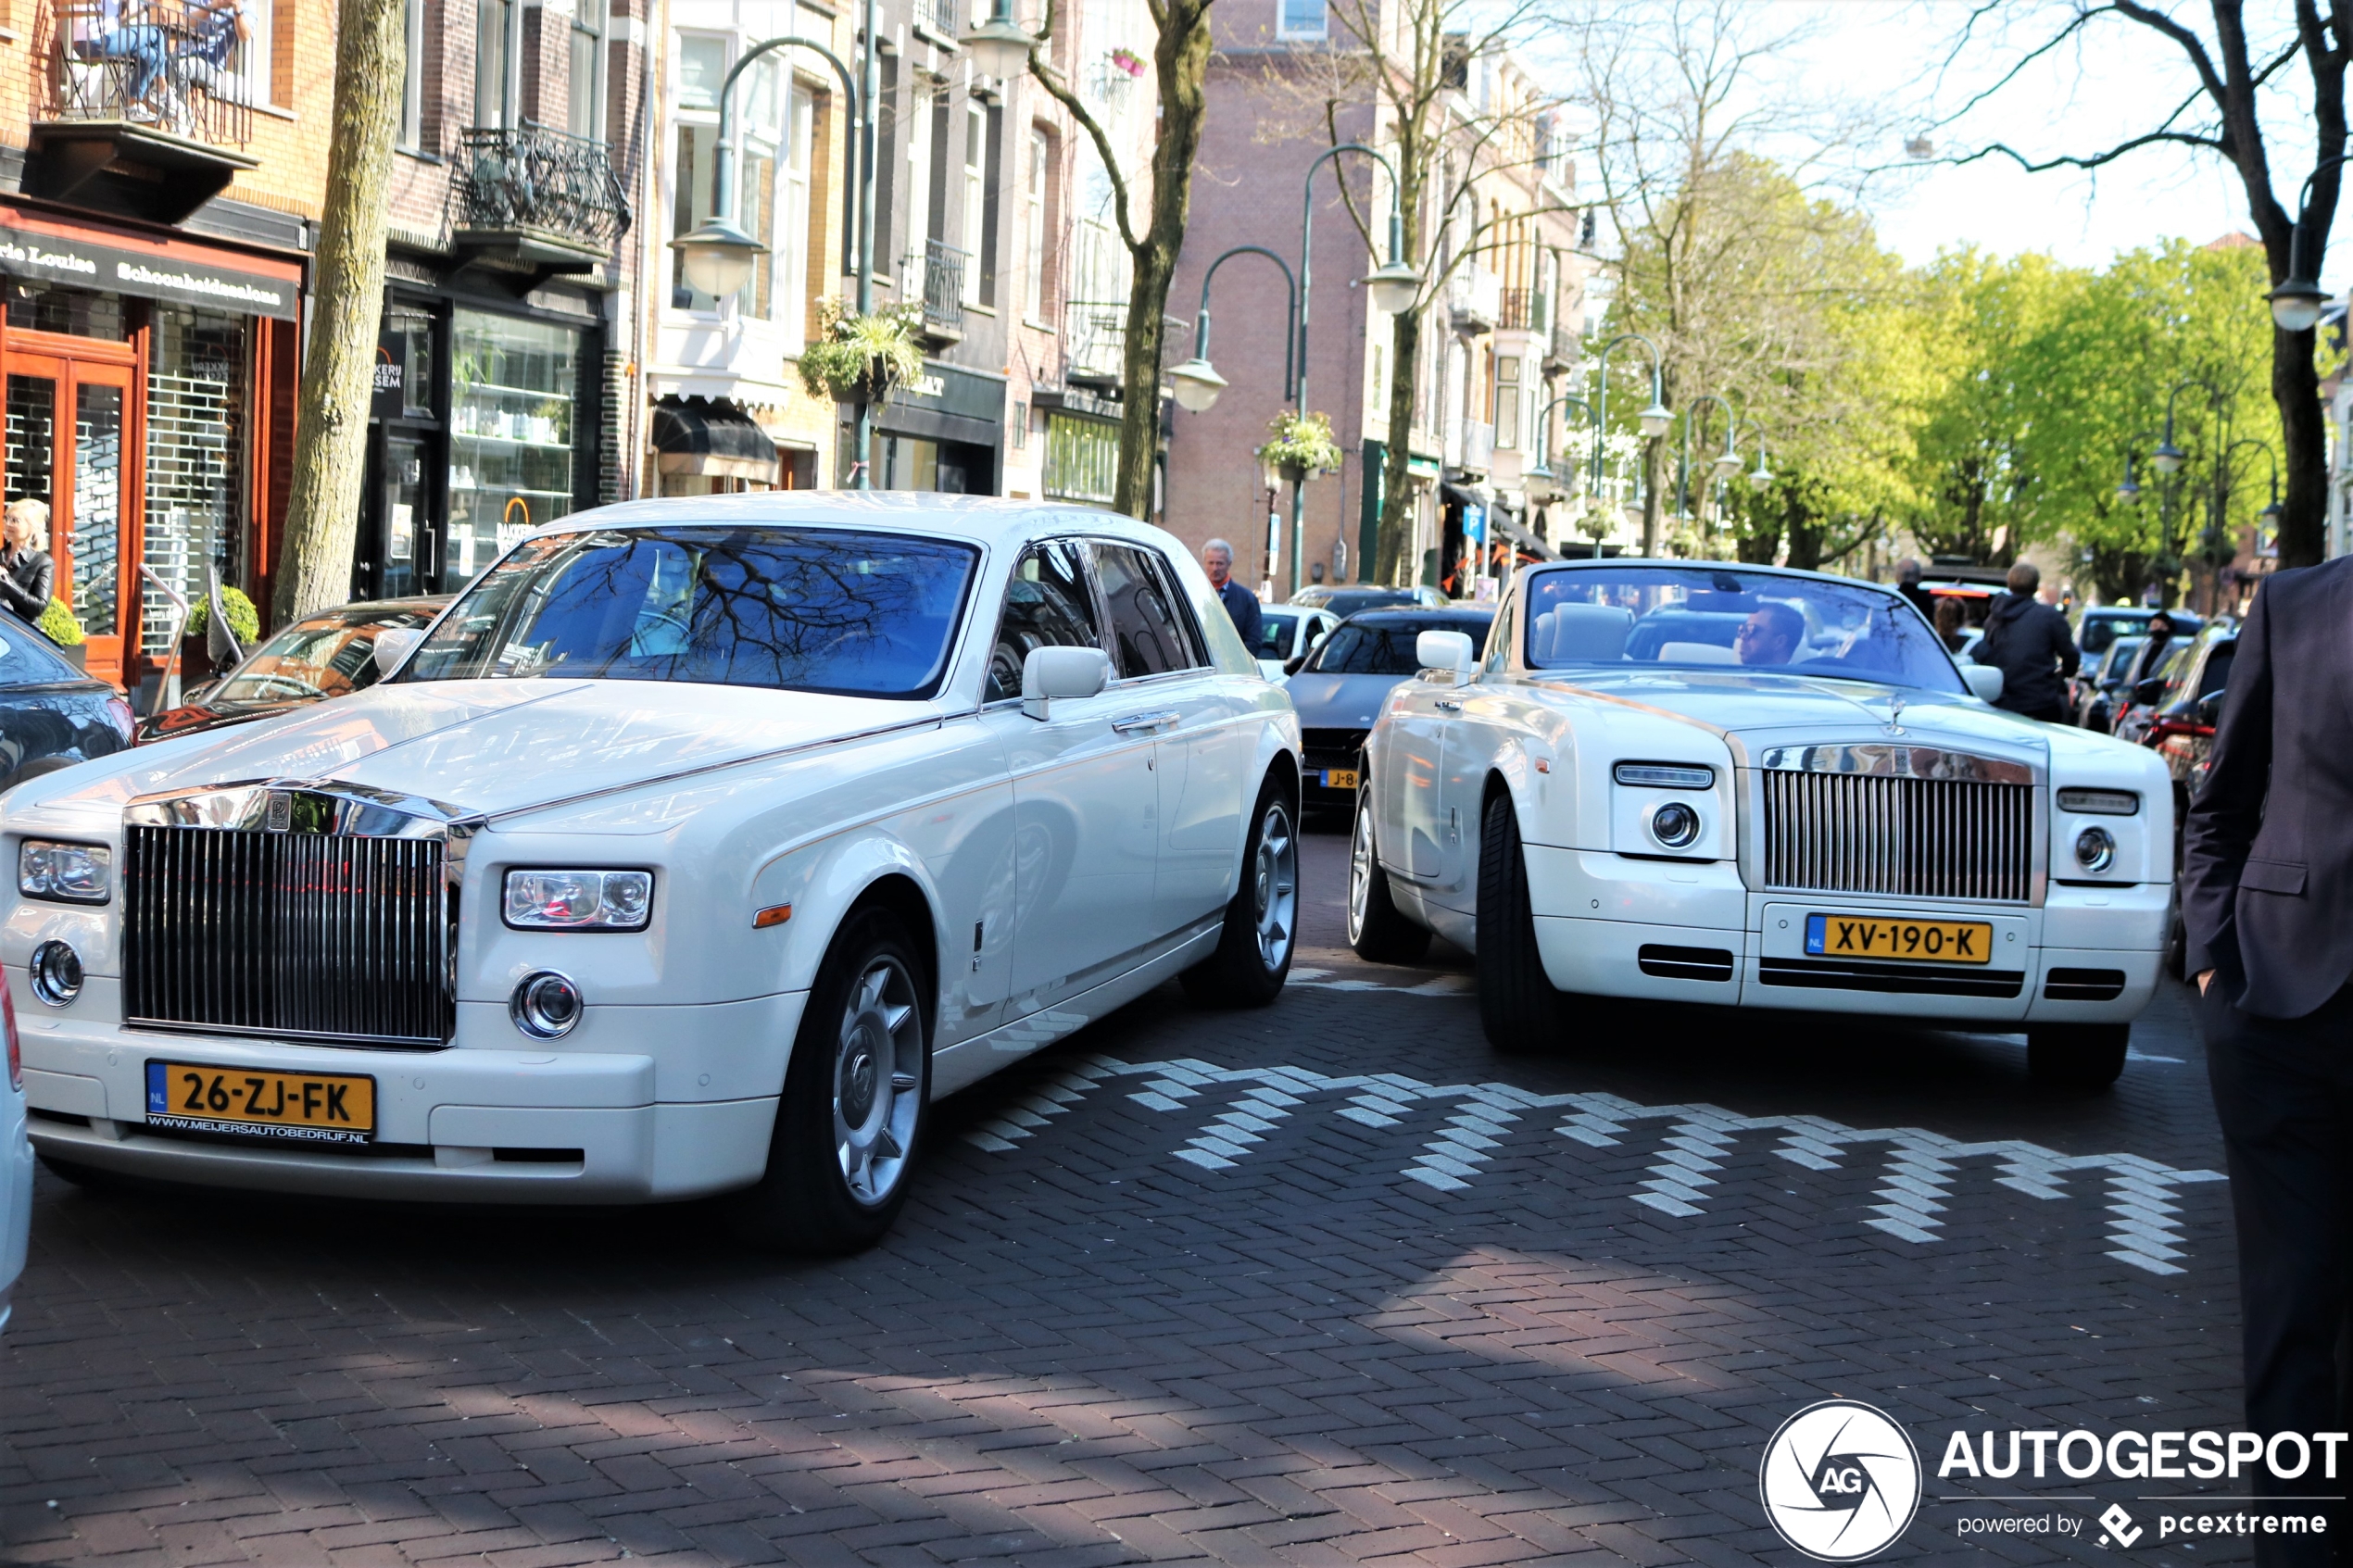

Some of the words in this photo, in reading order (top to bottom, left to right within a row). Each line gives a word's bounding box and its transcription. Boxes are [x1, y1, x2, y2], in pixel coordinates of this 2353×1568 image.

[28, 245, 96, 274] Louise
[372, 375, 401, 388] SEM
[1469, 517, 1479, 532] P
[1334, 772, 1358, 785] J-8
[1809, 938, 1822, 947] NL
[1836, 922, 1974, 956] XV-190-K
[150, 1093, 165, 1104] NL
[183, 1073, 350, 1122] 26-ZJ-FK
[147, 1116, 370, 1145] WWW.MEIJERSAUTOBEDRIJF.NL
